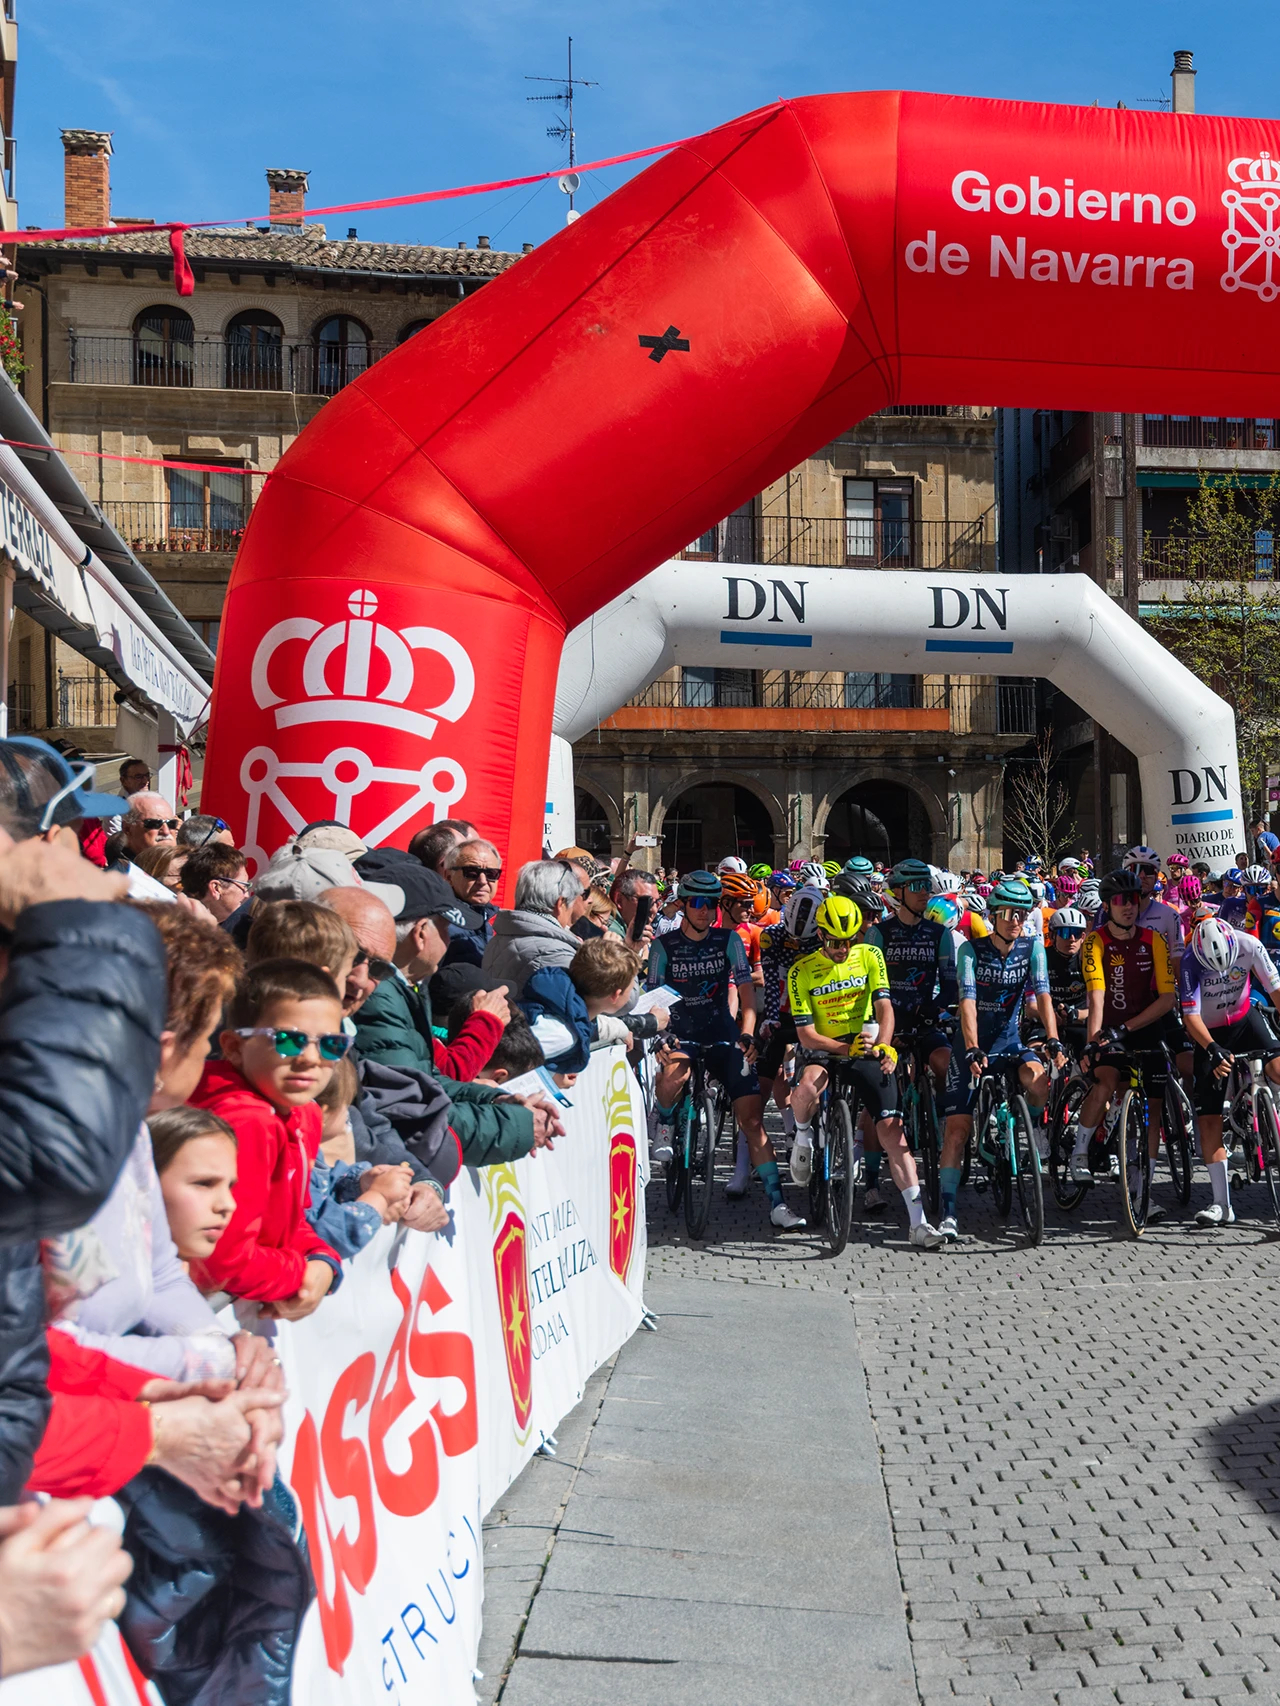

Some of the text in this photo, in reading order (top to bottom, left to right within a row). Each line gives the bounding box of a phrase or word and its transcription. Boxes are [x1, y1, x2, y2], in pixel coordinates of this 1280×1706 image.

[951, 169, 1197, 227] Gobierno
[904, 231, 1195, 291] de Navarra
[722, 576, 809, 623] DN
[928, 585, 1011, 630] DN
[1168, 765, 1228, 806] DN
[1175, 828, 1235, 845] DIARIO DE
[672, 958, 725, 973] BAHRAIN
[887, 947, 935, 956] BAHRAIN
[1085, 934, 1096, 973] Cofidis
[813, 975, 868, 996] anicolor
[976, 966, 1028, 979] BAHRAIN
[1110, 965, 1127, 1010] Cofidis
